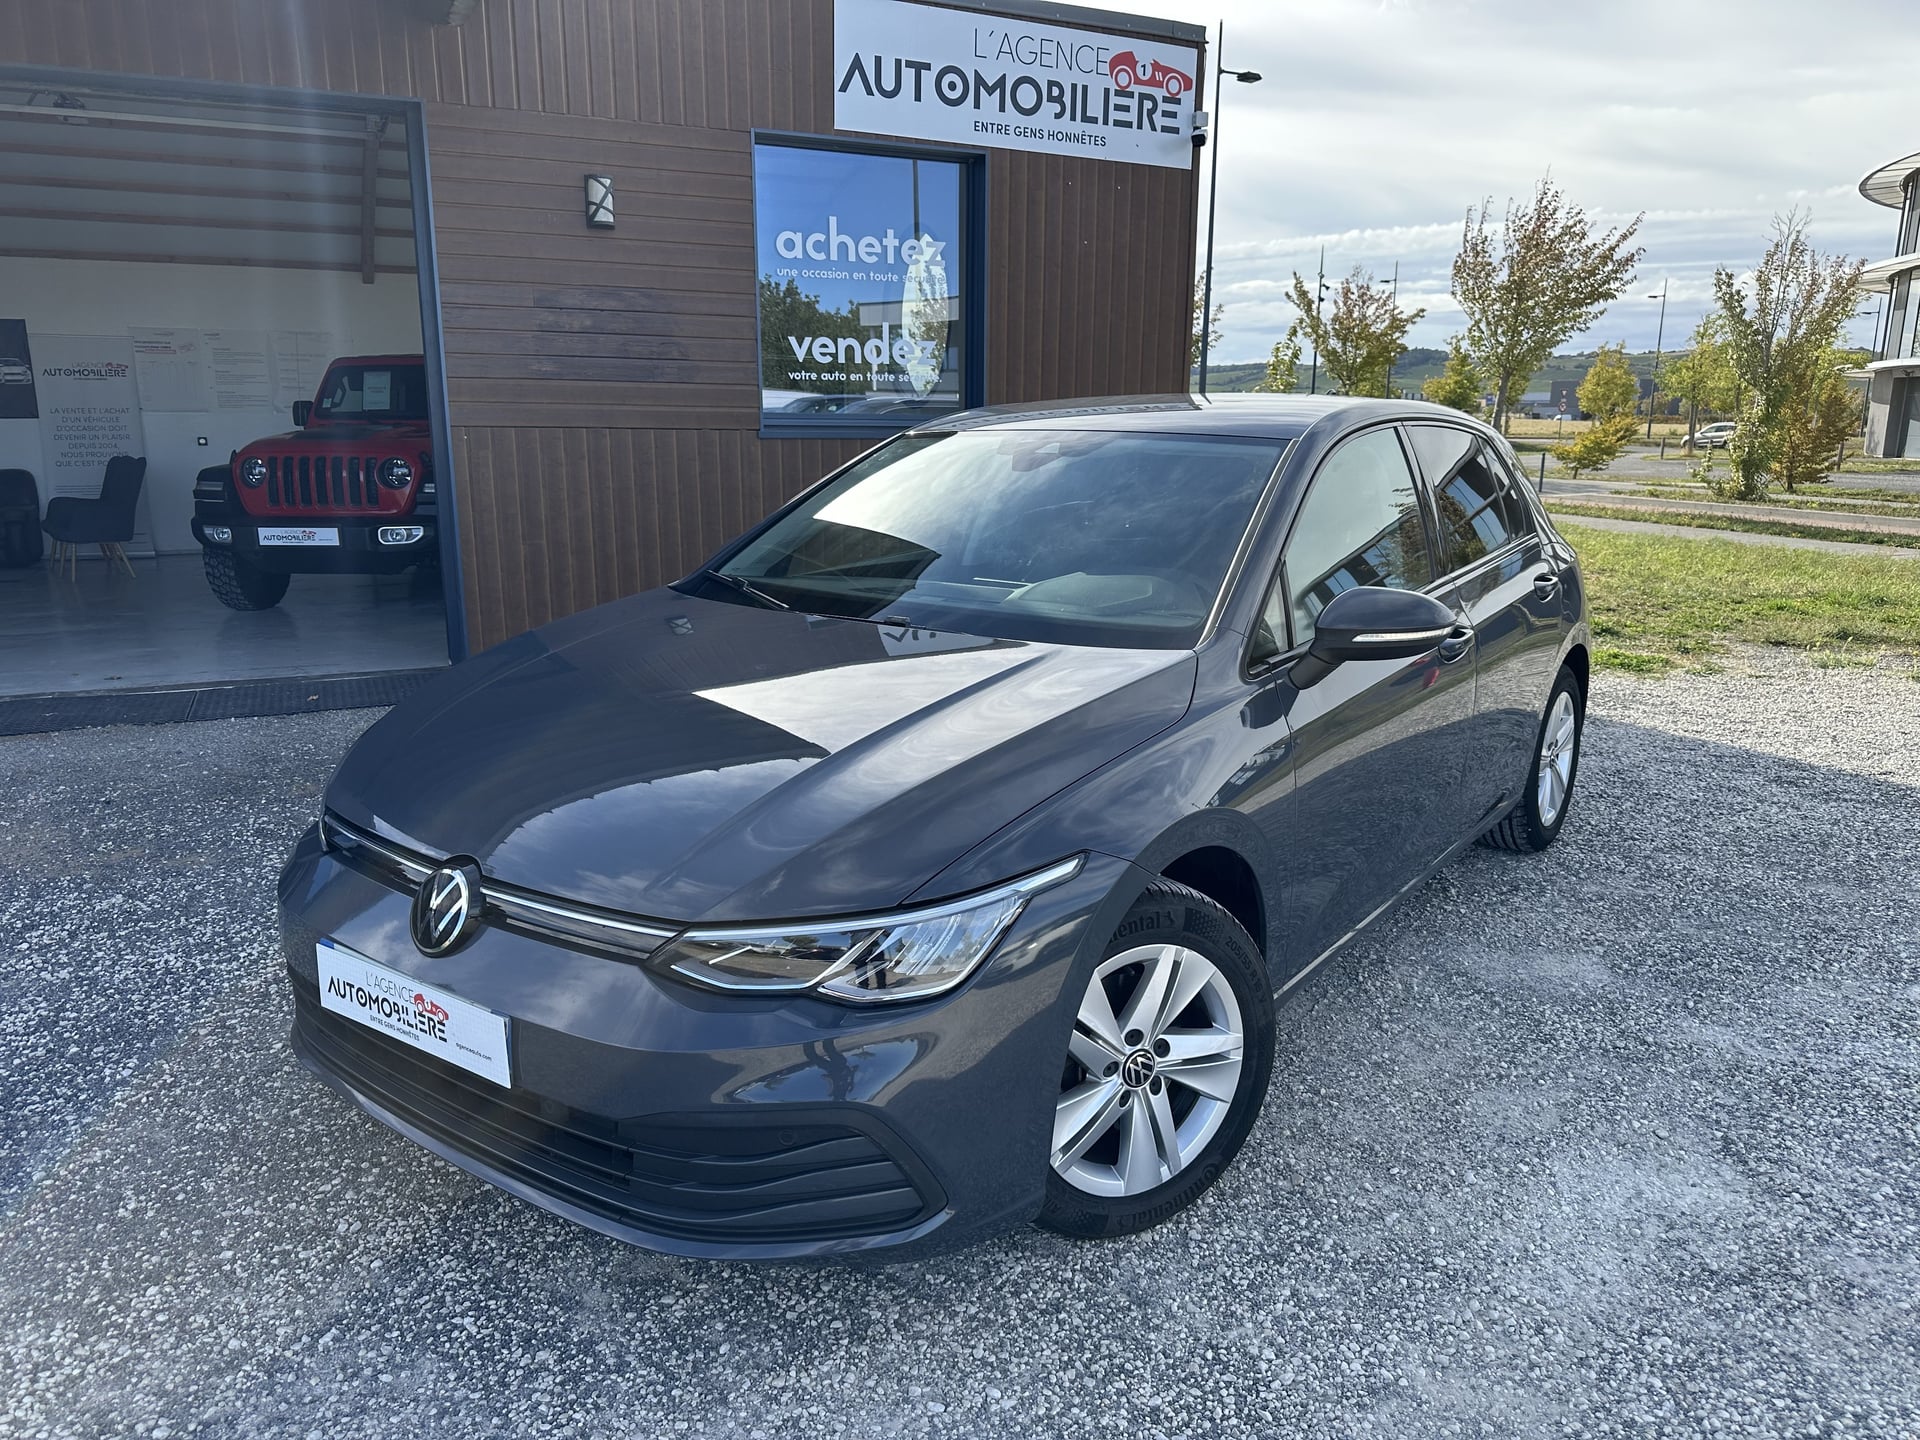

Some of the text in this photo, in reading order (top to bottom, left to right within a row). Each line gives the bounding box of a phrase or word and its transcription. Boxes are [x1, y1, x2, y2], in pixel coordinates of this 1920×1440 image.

[974, 27, 1109, 76] L'AGENCE
[974, 121, 1107, 147] ENTRE GENS HONNÊTES
[775, 215, 946, 269] achetez
[777, 267, 798, 277] une
[801, 267, 849, 280] occasion
[852, 272, 866, 281] en
[869, 271, 899, 282] toute
[788, 322, 937, 366] vendez
[788, 371, 818, 381] votre
[821, 371, 847, 381] auto
[850, 373, 863, 382] en
[866, 372, 895, 382] toute
[366, 971, 414, 1004] L'AGENCE
